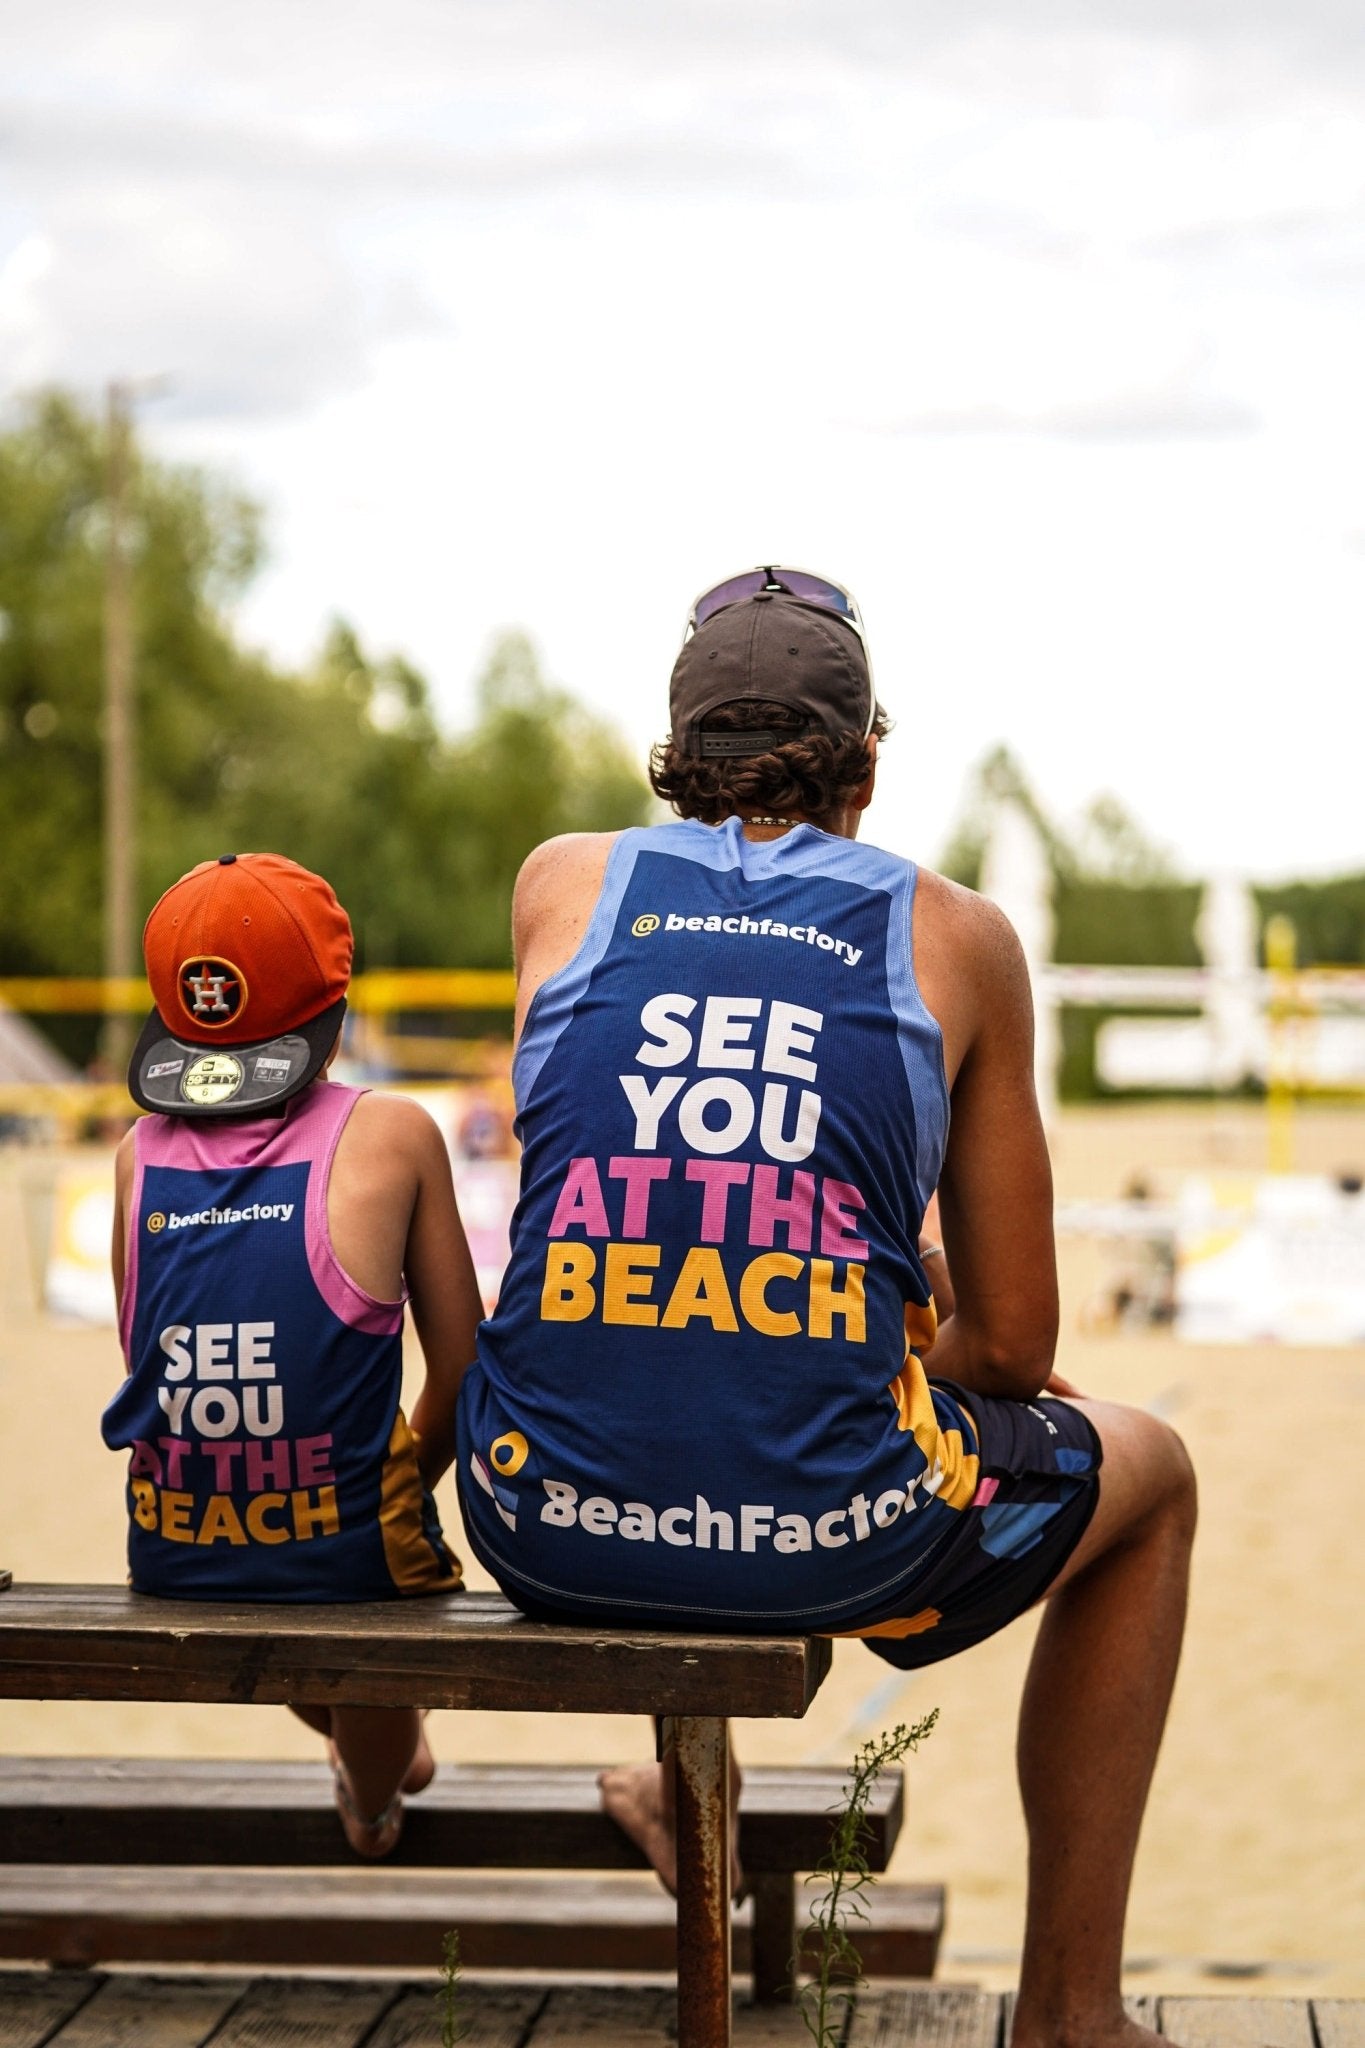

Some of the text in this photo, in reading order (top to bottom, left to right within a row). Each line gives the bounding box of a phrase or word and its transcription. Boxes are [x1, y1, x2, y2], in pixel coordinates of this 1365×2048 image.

[189, 976, 229, 1012] H
[635, 993, 824, 1083] SEE
[619, 1075, 822, 1163] YOU
[547, 1157, 869, 1260] AT THE
[540, 1242, 867, 1344] BEACH
[159, 1321, 276, 1382] SEE
[157, 1385, 284, 1438] YOU
[131, 1433, 336, 1492] AT THE
[131, 1478, 341, 1545] BEACH
